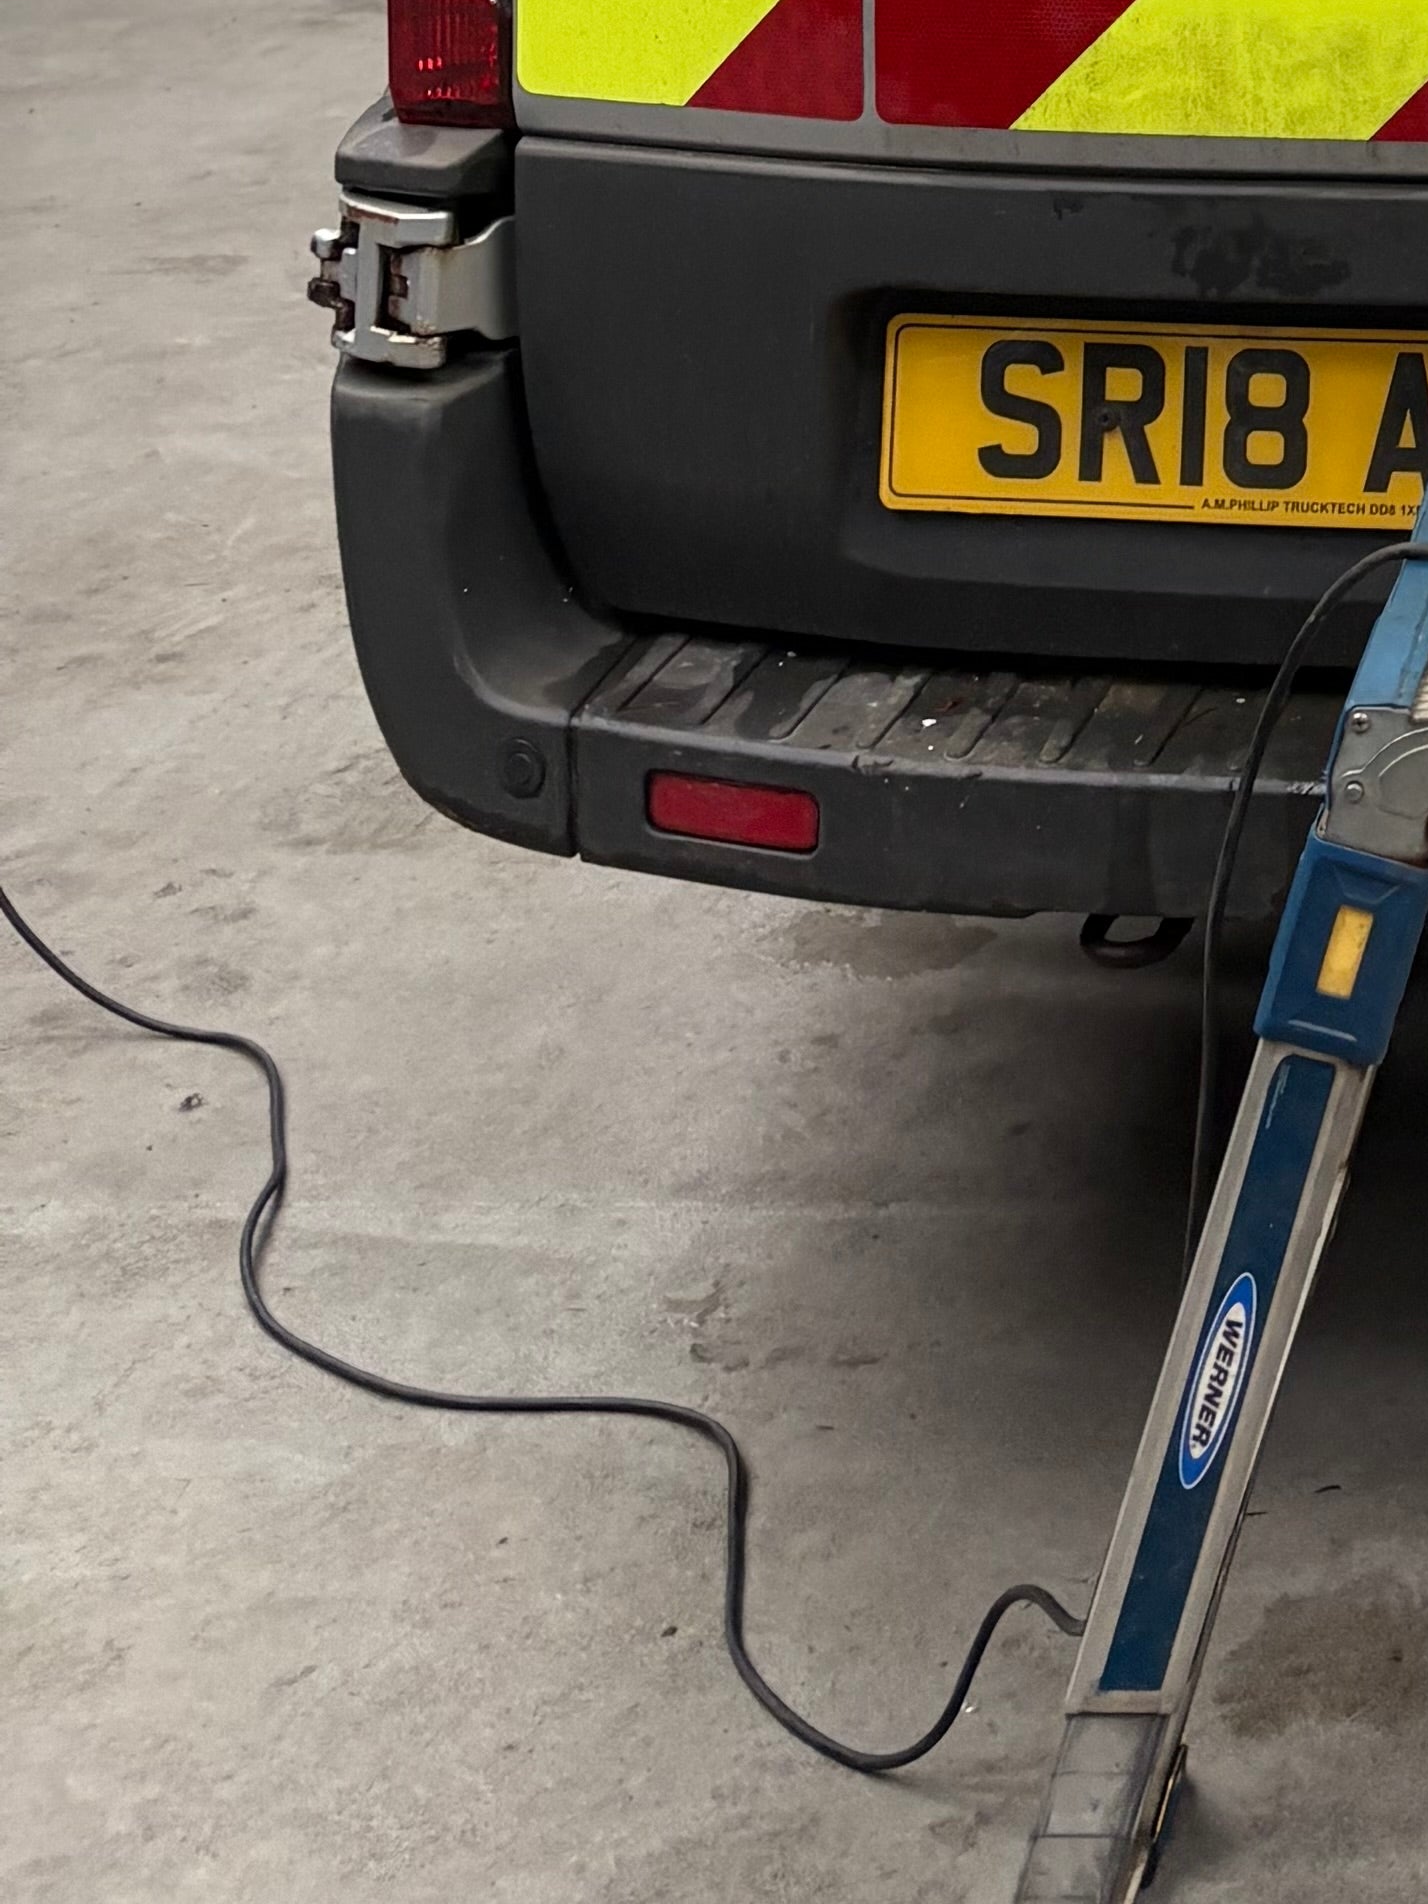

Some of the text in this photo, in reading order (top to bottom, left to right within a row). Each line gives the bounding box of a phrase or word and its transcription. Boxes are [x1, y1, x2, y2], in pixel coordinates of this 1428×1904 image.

[1284, 500, 1366, 515] TRUCKTECH
[1370, 502, 1396, 516] DD8
[1192, 1318, 1244, 1448] WERNER
